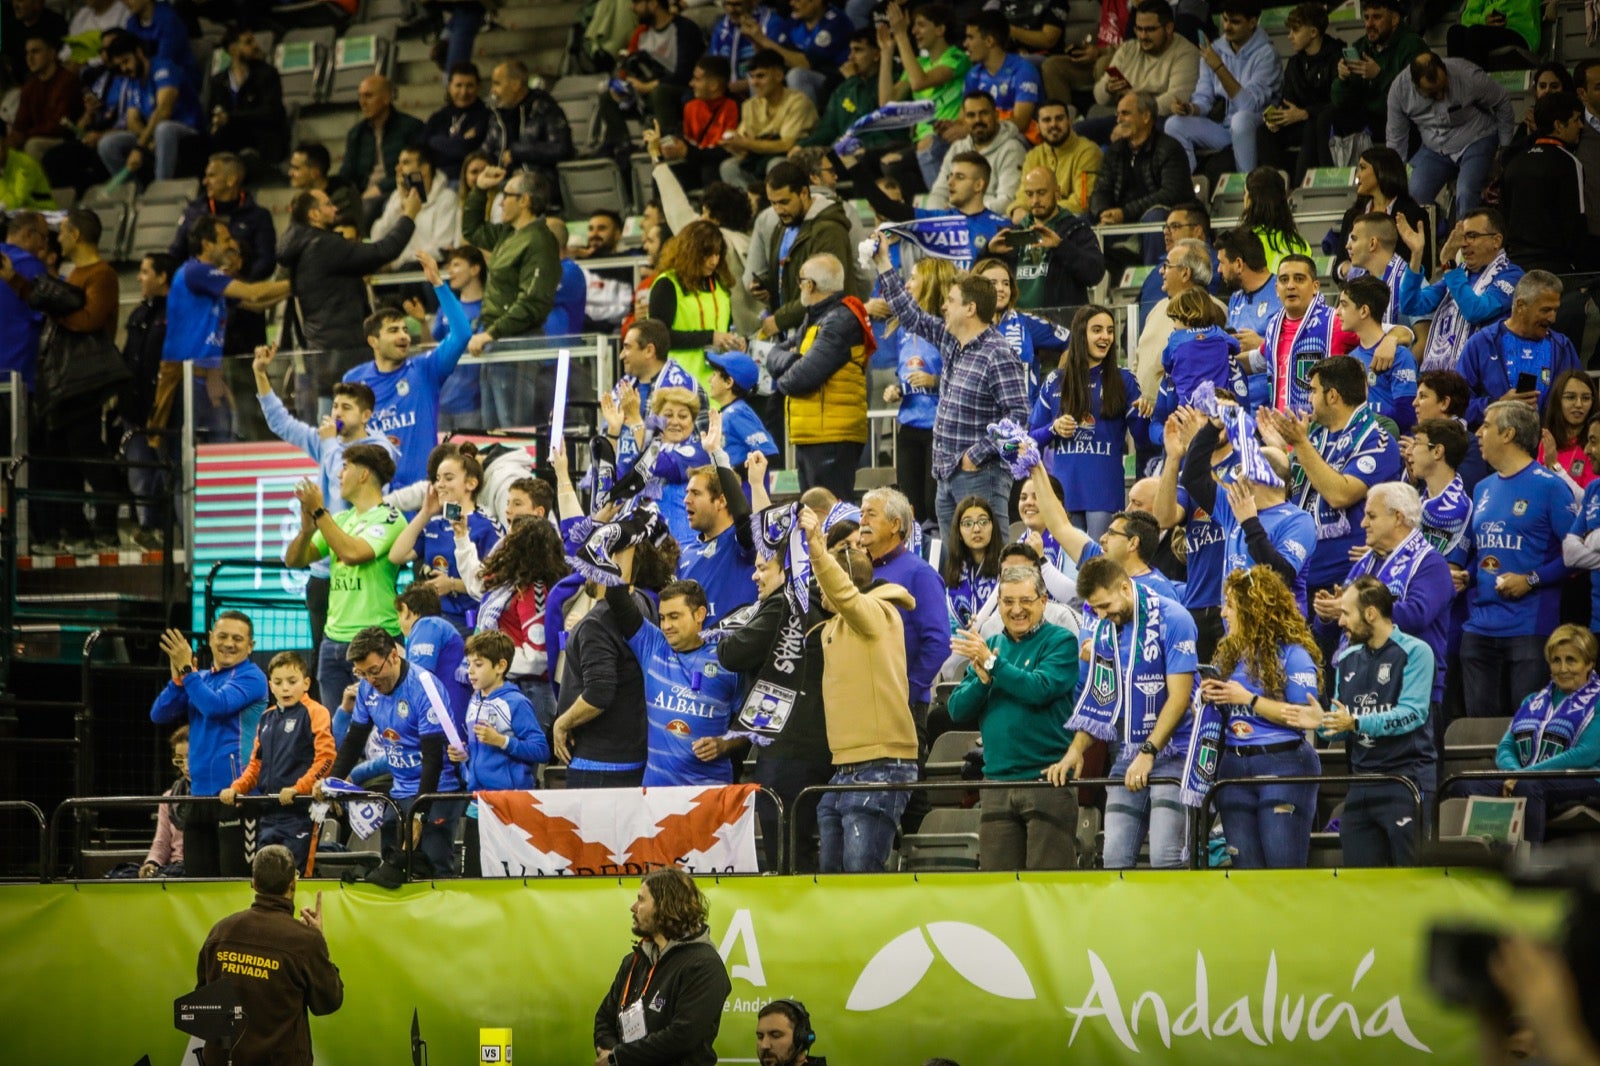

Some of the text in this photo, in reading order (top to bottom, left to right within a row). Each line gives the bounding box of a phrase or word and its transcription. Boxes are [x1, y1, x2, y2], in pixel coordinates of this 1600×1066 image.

[1056, 440, 1112, 456] ALBALI
[653, 691, 715, 719] ALBALI
[216, 951, 279, 971] SEGURIDAD
[221, 962, 269, 980] PRIVADA
[1064, 948, 1433, 1053] Andalucía
[484, 1048, 497, 1058] VS
